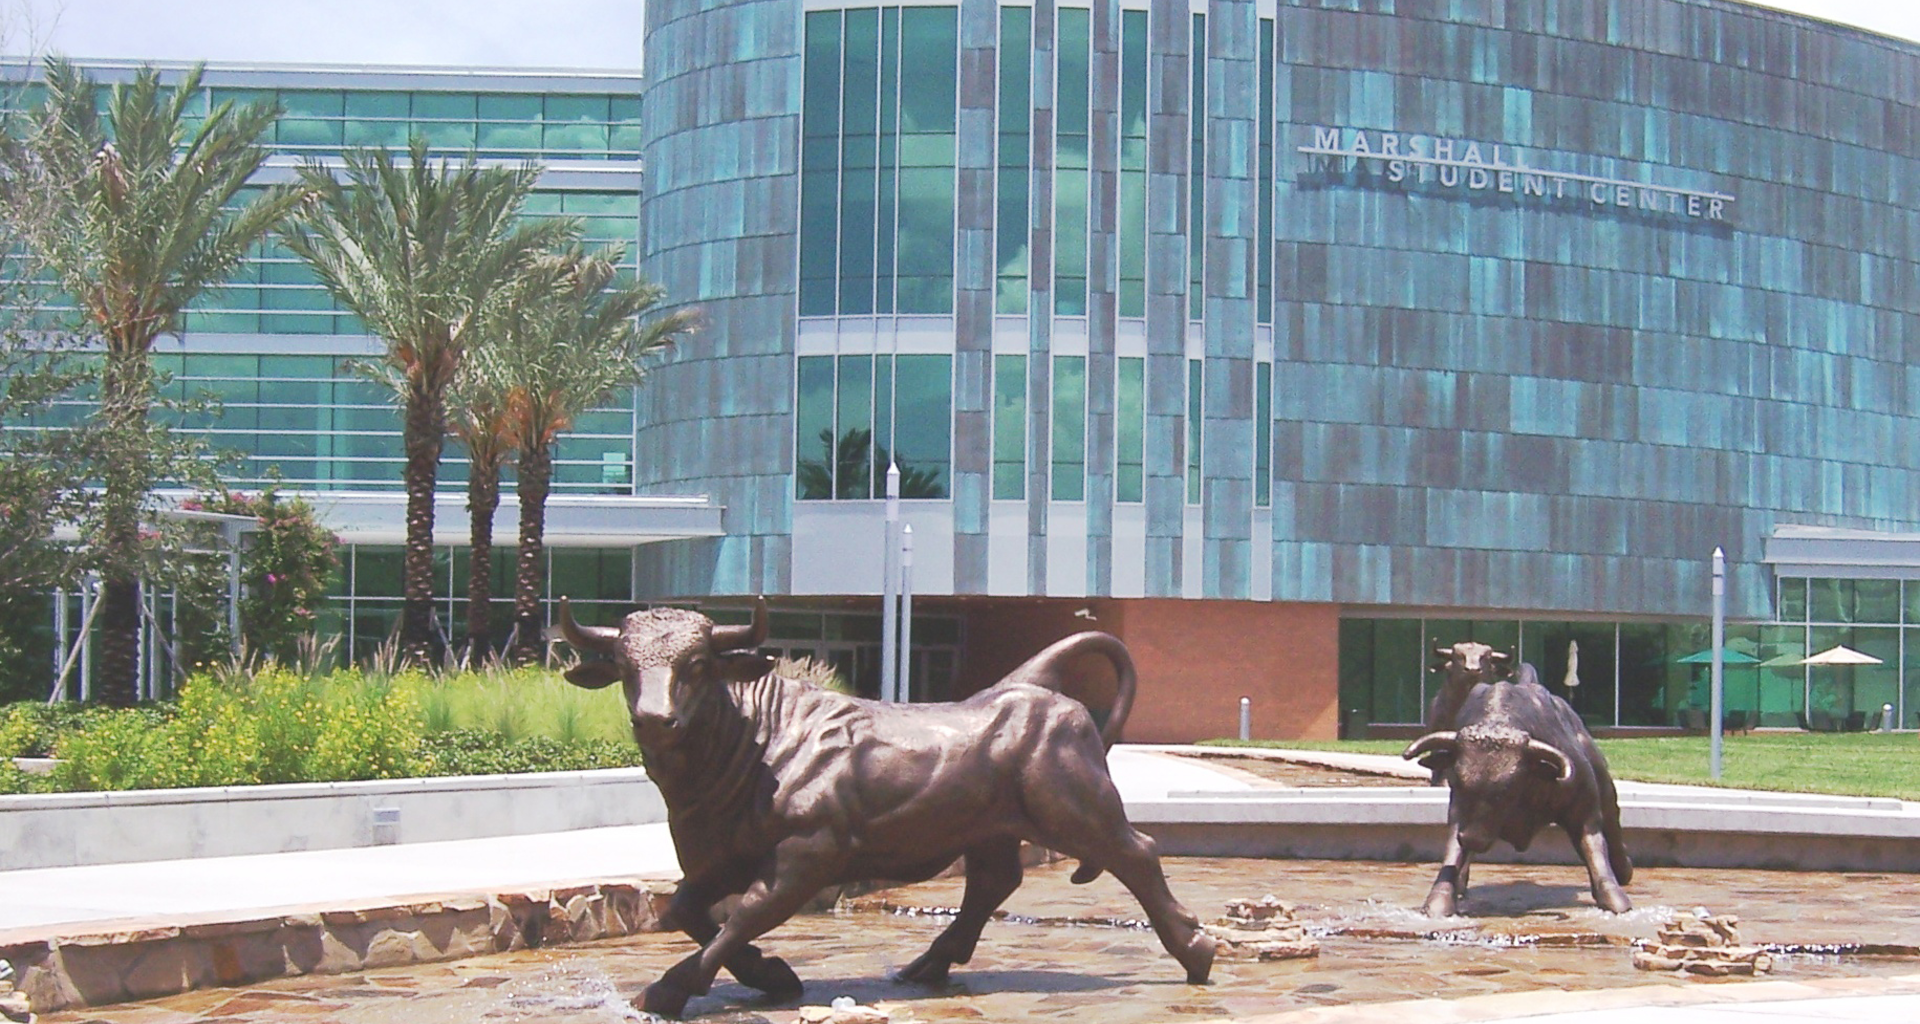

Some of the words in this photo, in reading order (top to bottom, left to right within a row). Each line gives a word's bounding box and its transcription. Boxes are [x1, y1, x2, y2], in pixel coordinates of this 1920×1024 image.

[1314, 127, 1530, 168] MARSHALL
[1388, 160, 1567, 199] STUDENT
[1591, 182, 1724, 219] CENTER
